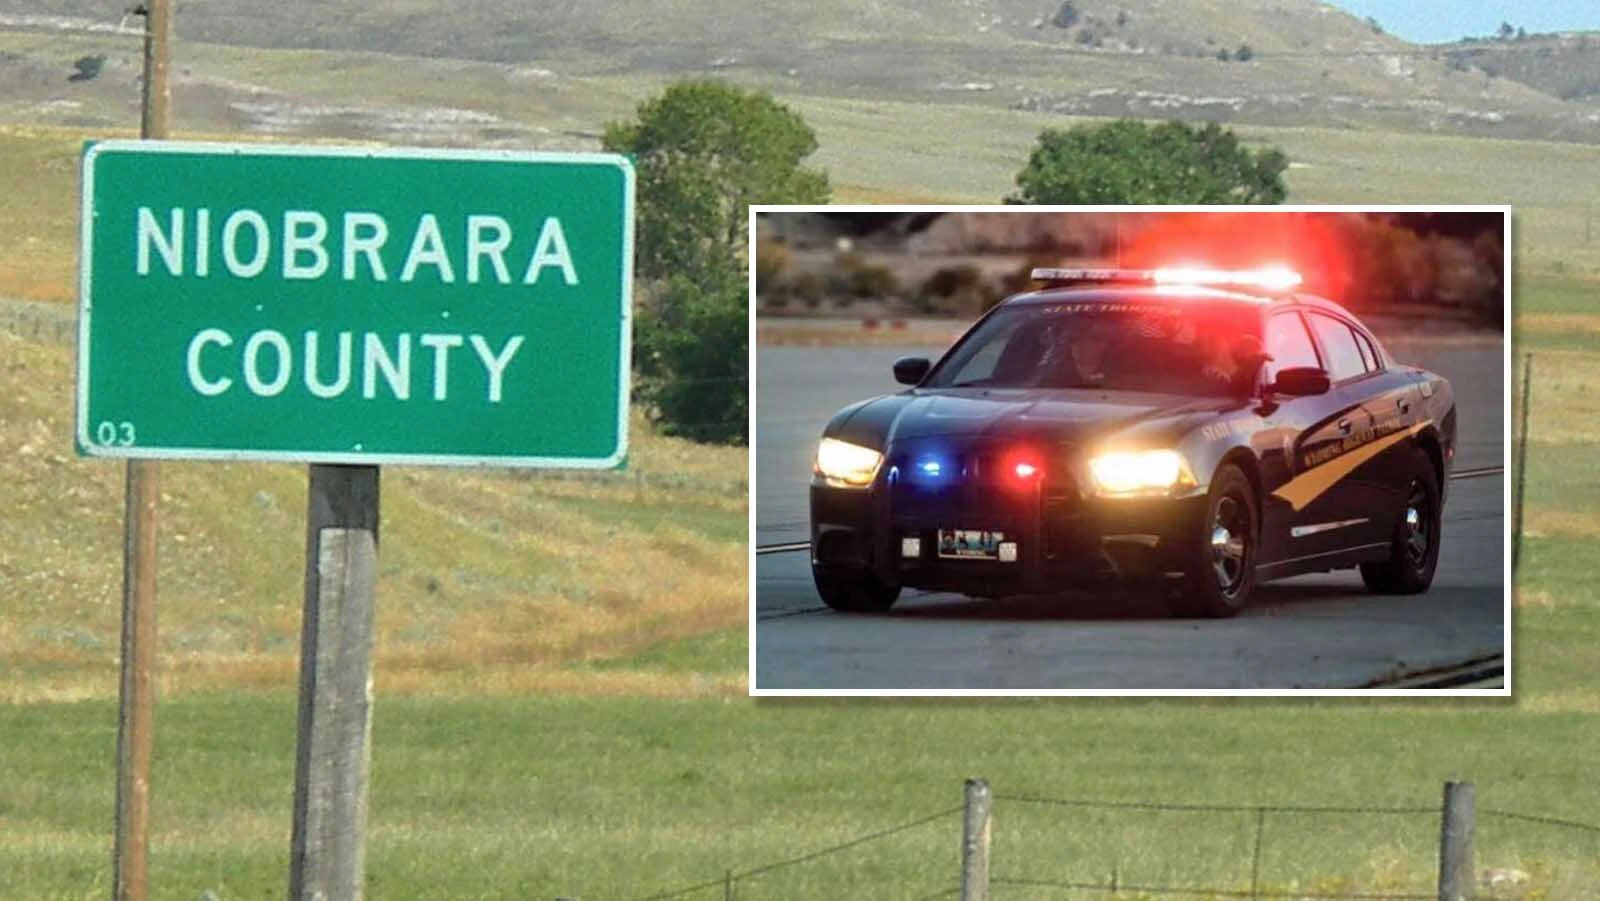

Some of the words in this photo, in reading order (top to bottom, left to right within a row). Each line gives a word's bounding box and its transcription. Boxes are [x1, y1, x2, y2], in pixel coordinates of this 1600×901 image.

[137, 207, 577, 285] NIOBRARA
[187, 329, 523, 402] COUNTY
[98, 421, 136, 446] 03
